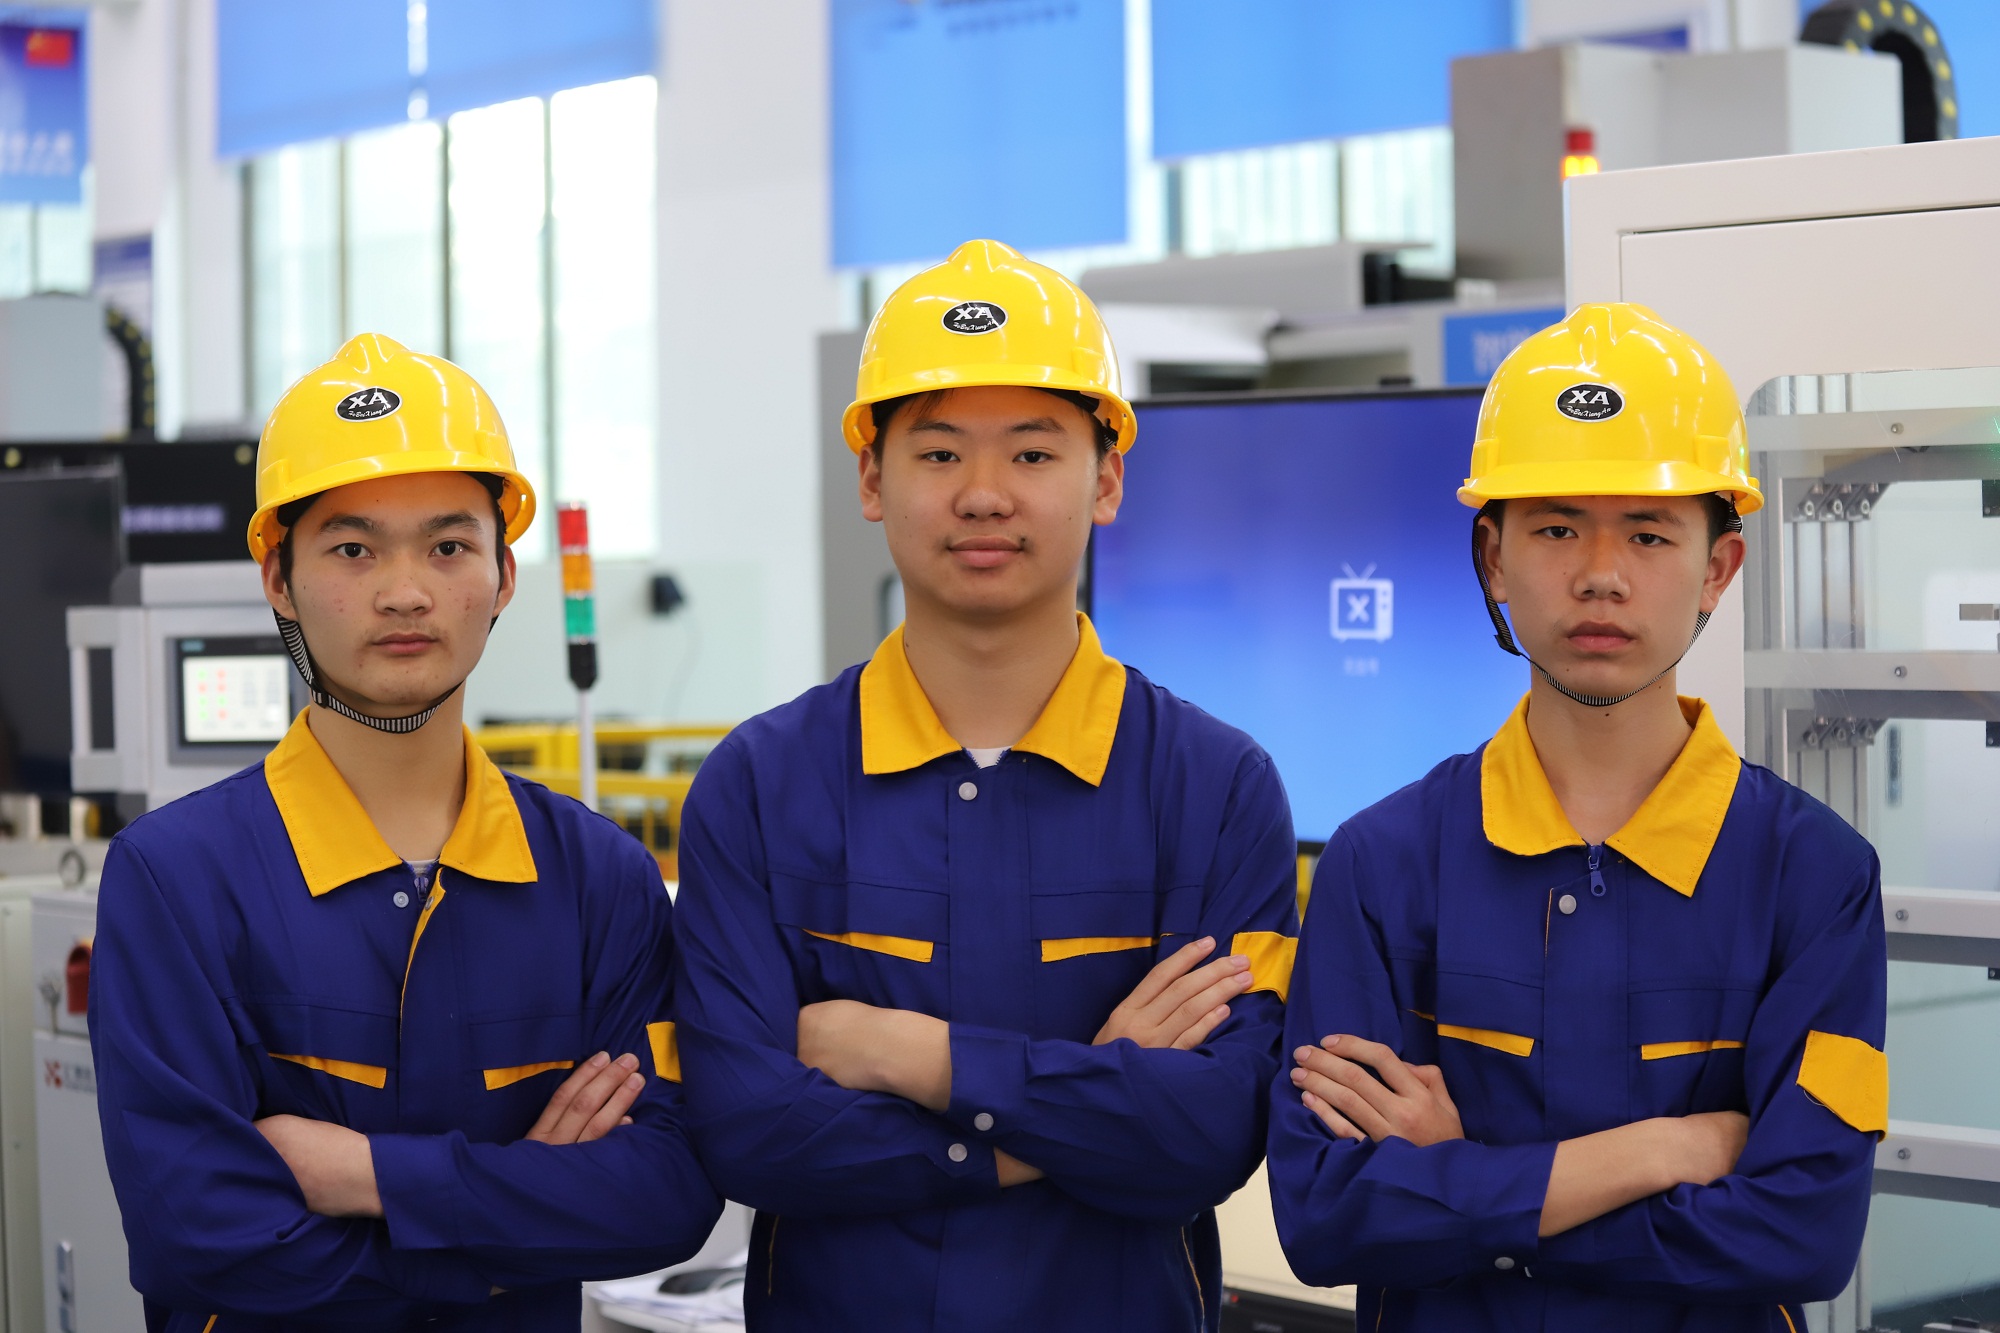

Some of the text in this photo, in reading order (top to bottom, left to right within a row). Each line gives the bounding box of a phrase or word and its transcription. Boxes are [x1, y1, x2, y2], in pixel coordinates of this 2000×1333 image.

[953, 306, 993, 321] XA
[348, 391, 388, 410] XA
[1567, 390, 1609, 405] XA
